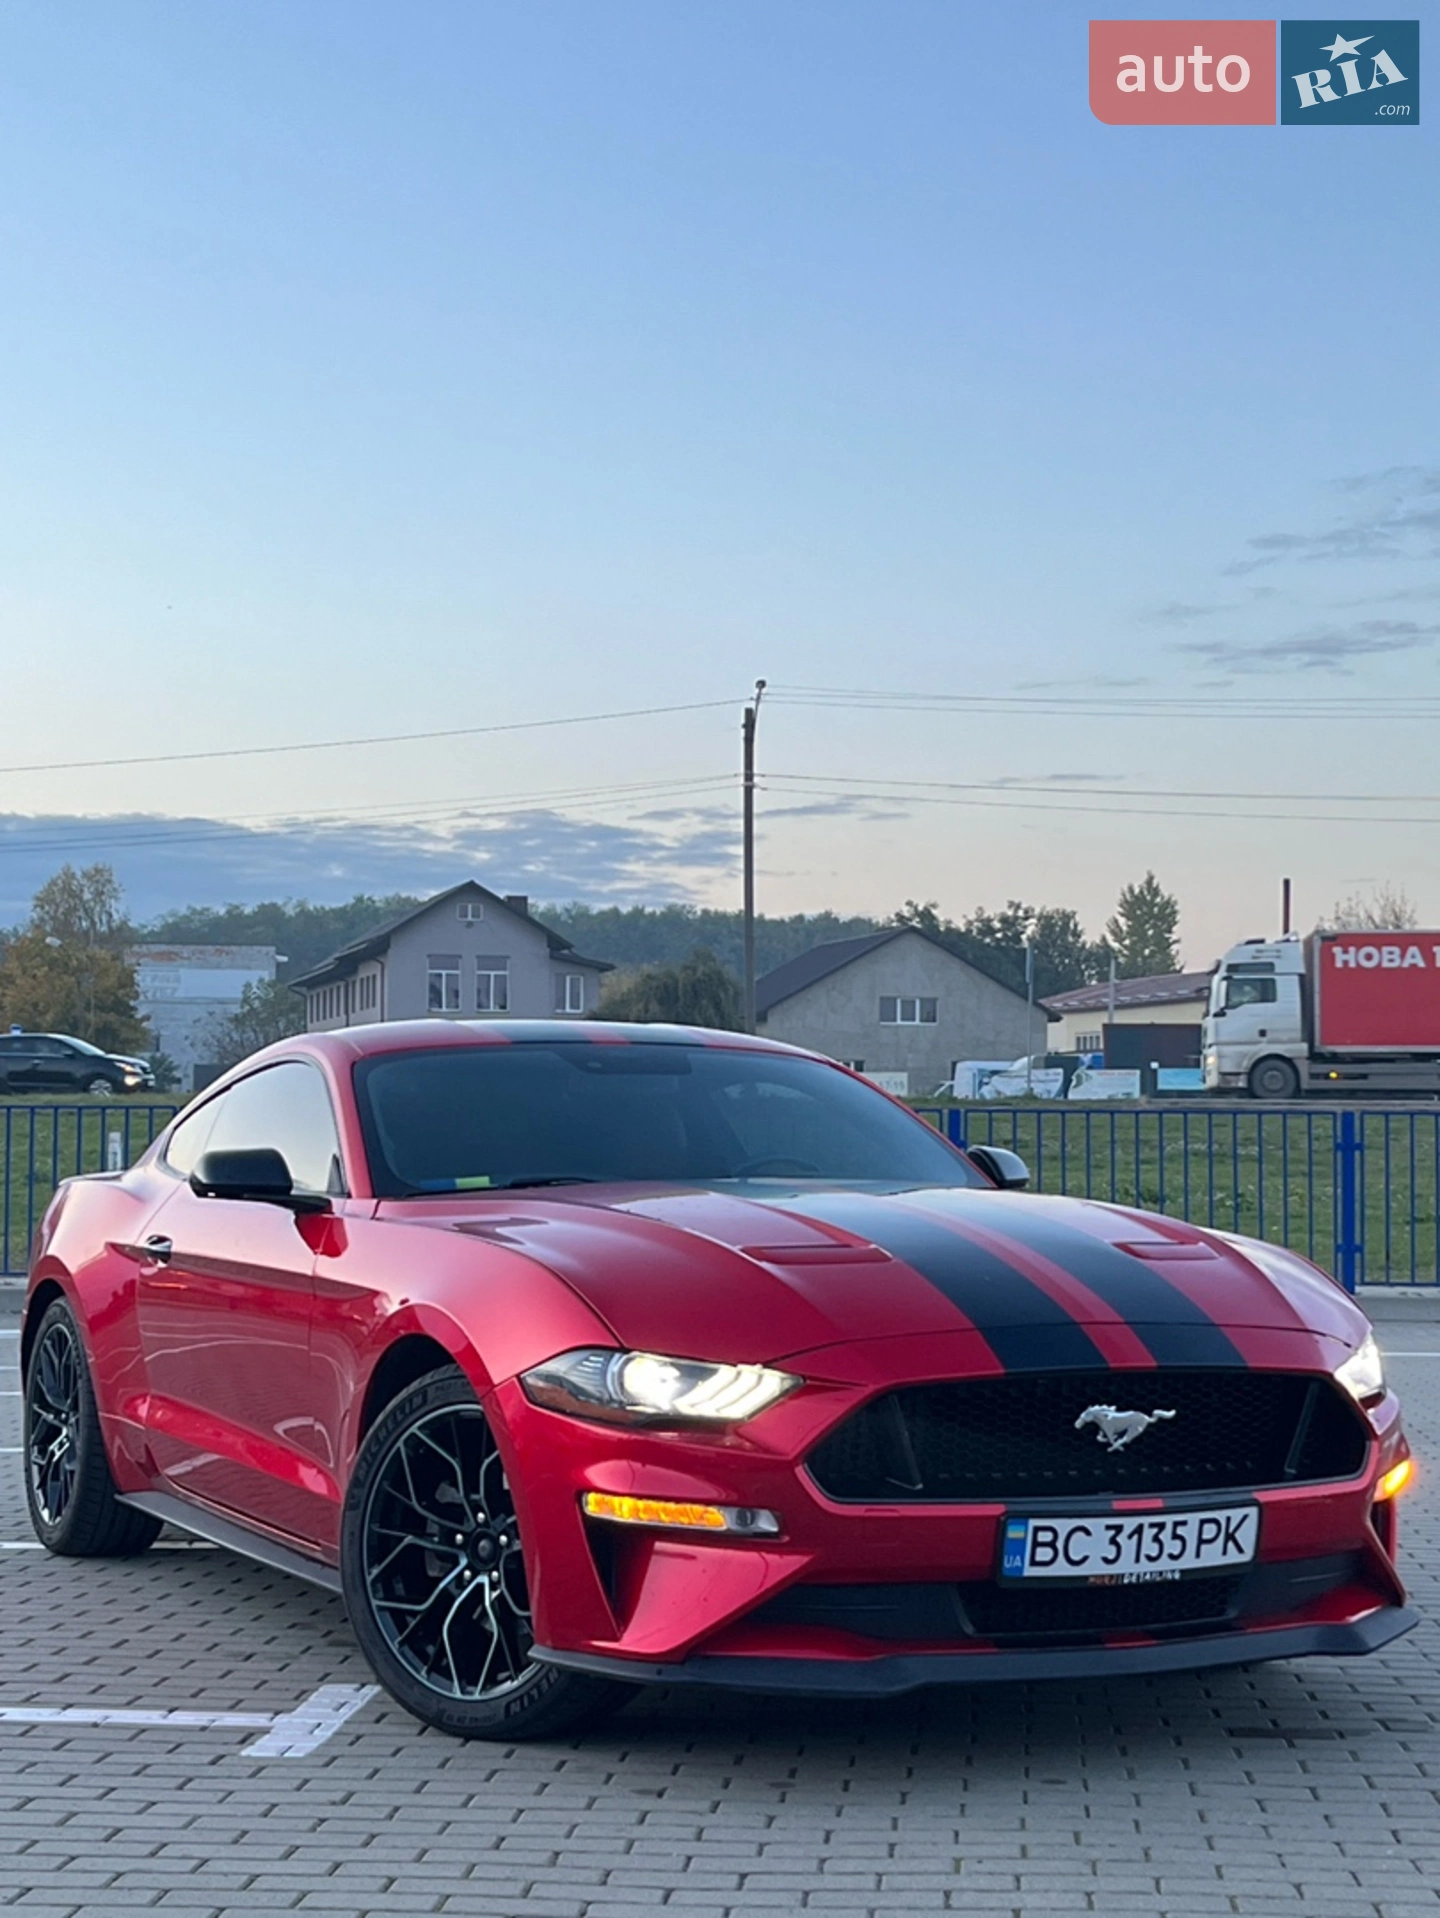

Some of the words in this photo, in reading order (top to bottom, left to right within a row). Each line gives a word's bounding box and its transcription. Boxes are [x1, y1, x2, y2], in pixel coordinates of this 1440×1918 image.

[1332, 945, 1426, 969] НОВА
[1028, 1525, 1093, 1568] BC
[1100, 1519, 1189, 1566] 3135
[1195, 1513, 1250, 1560] PK
[1004, 1554, 1023, 1569] UA
